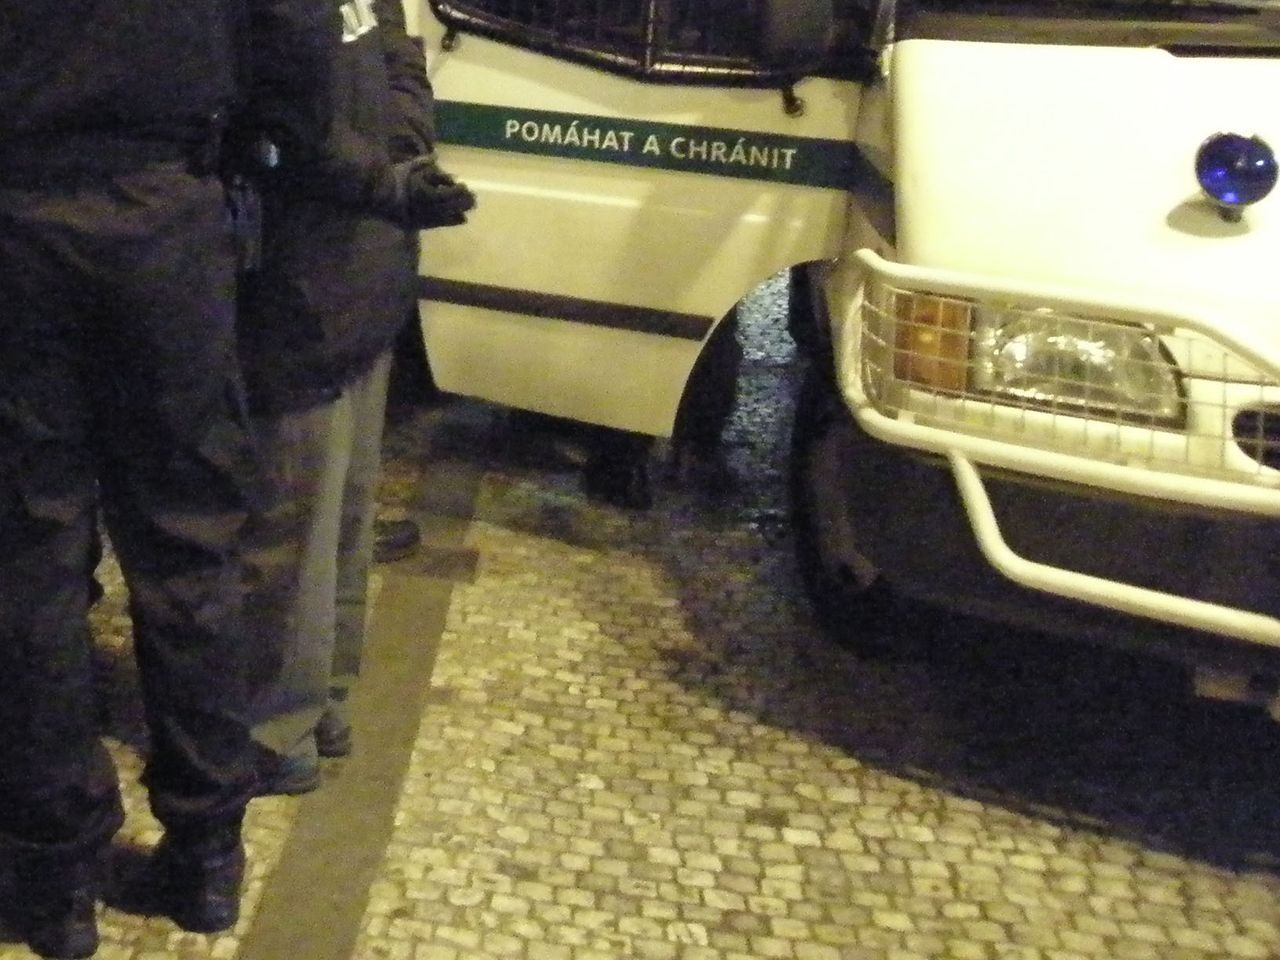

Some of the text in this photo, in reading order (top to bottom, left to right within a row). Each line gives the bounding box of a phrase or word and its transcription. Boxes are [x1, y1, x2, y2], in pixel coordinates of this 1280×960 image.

[505, 119, 797, 170] POMÁHAT A CHRÁNIT
